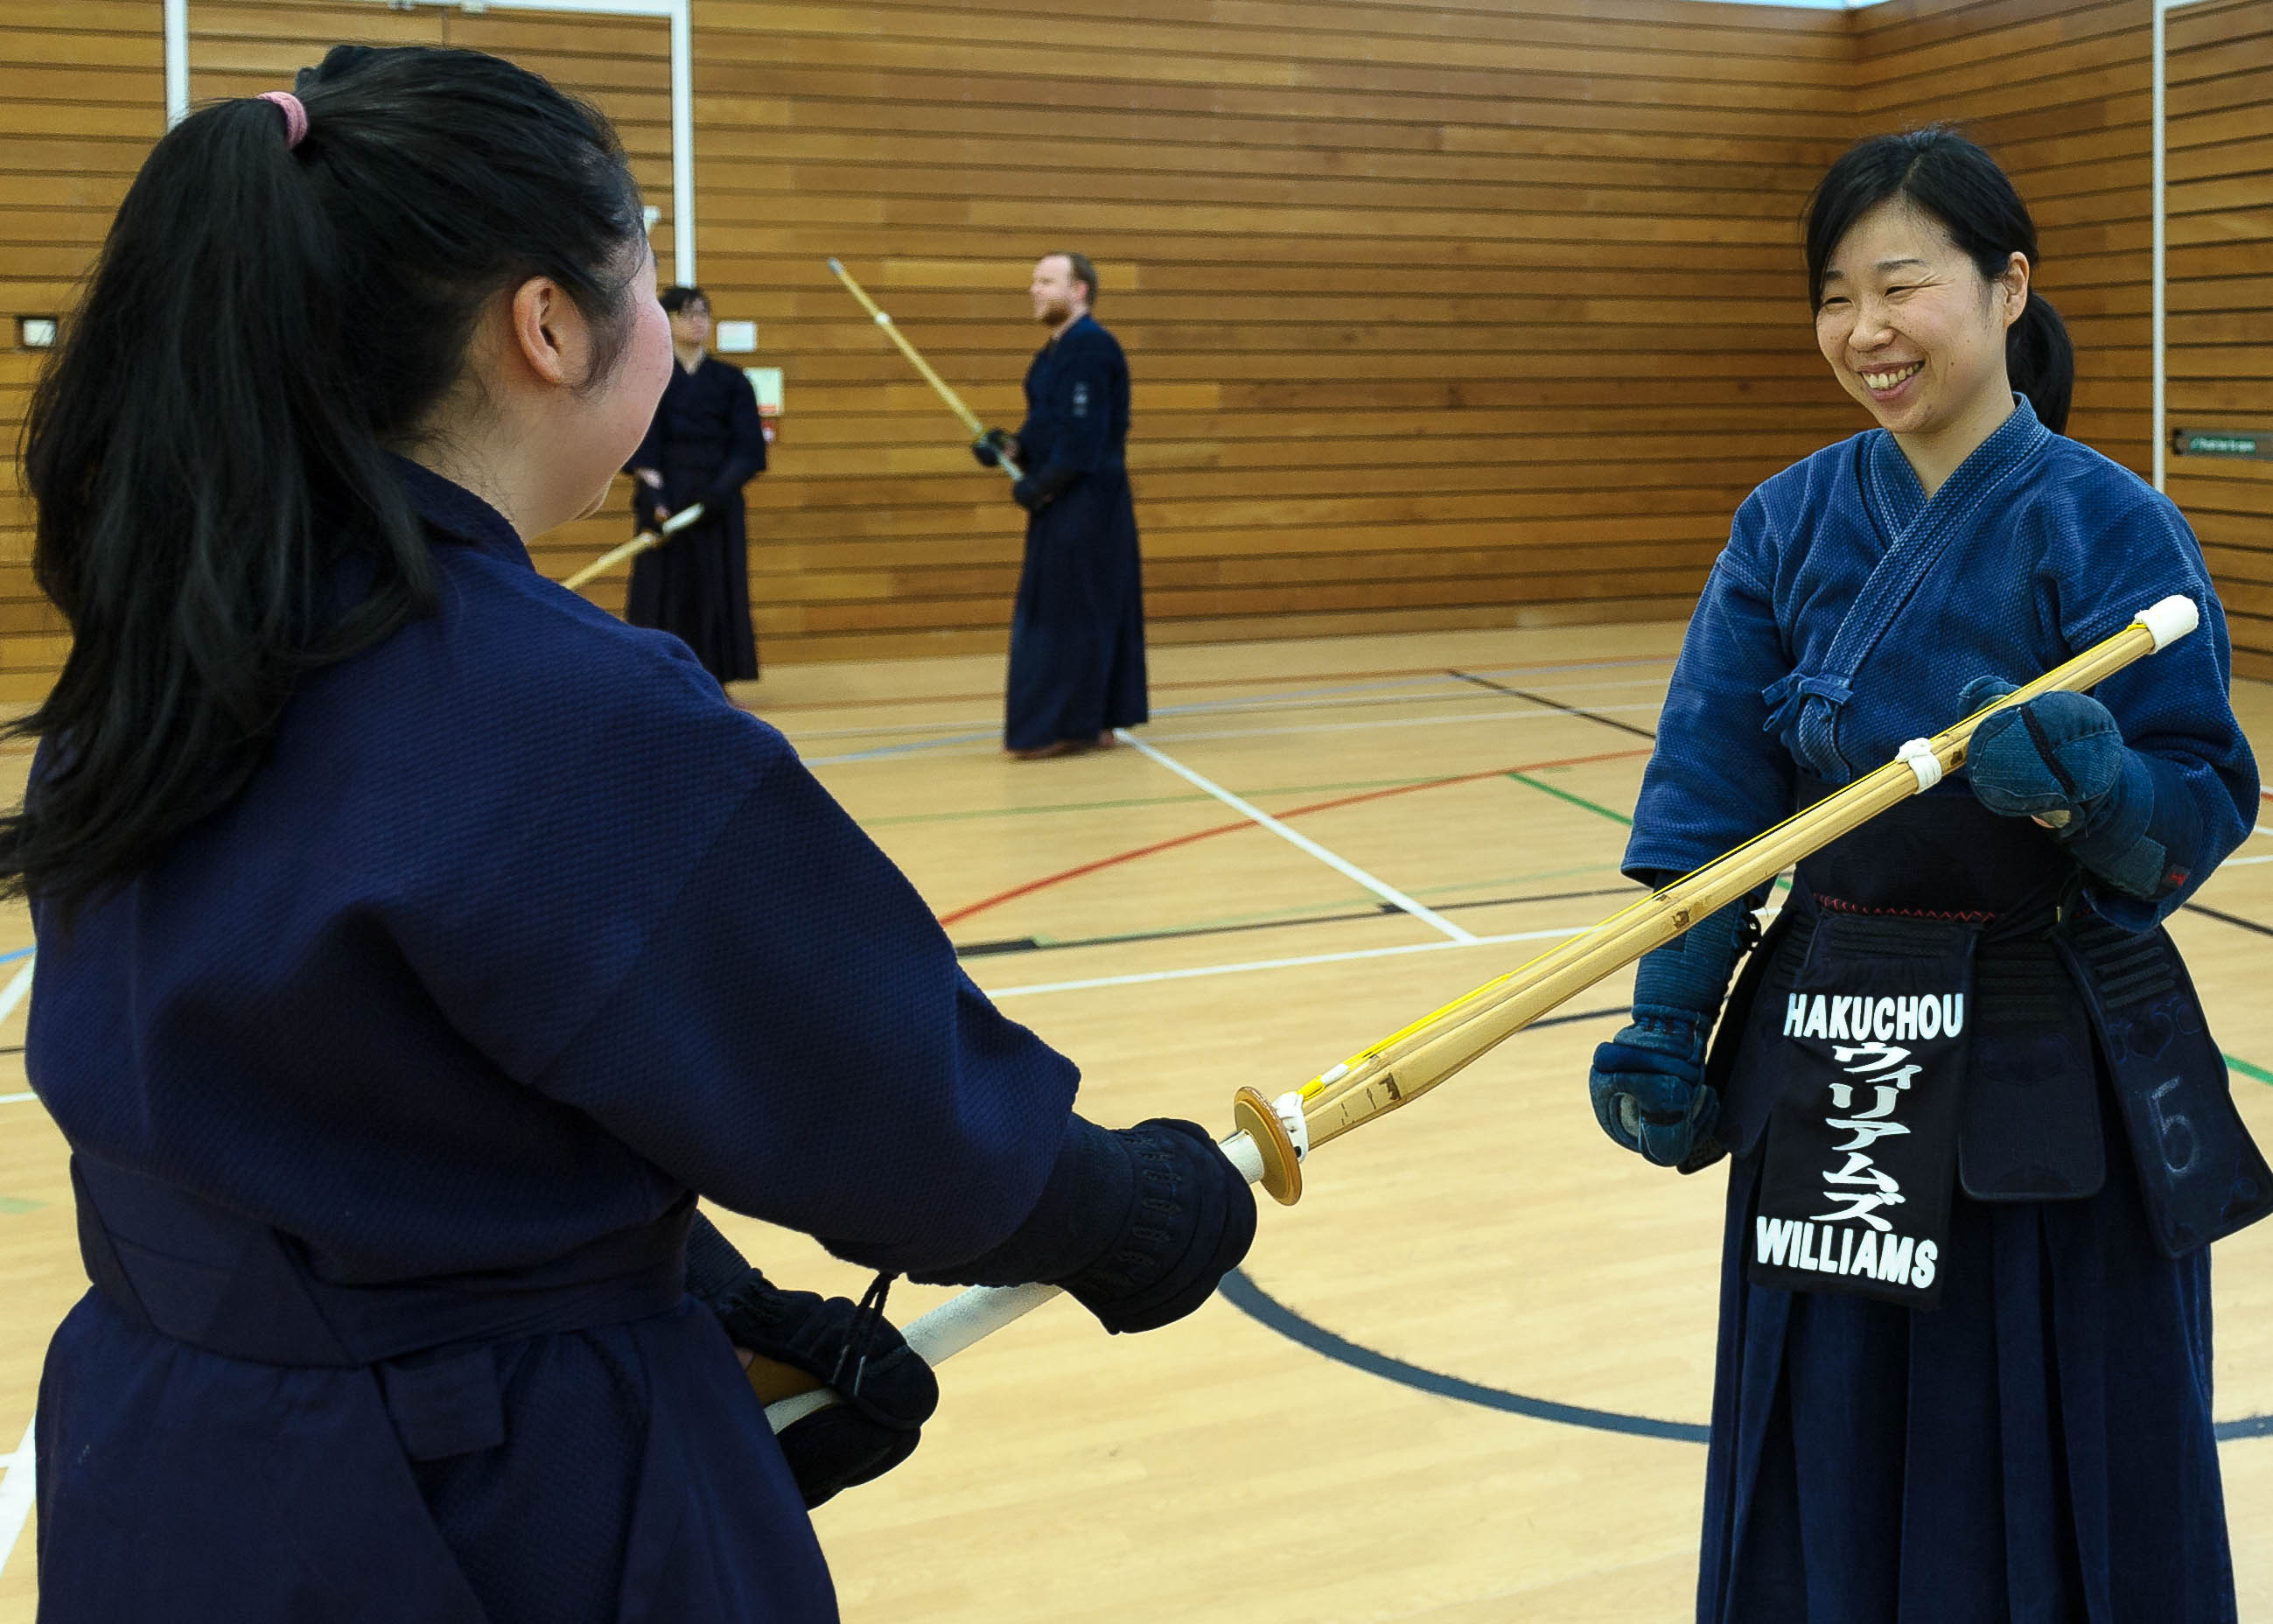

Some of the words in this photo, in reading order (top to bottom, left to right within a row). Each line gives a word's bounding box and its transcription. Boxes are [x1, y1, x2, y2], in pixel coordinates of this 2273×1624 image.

[1783, 993, 1964, 1041] HAKUCHOU
[1808, 1041, 1923, 1232] ウィリアムズ
[1756, 1215, 1939, 1289] WILLIAMS
